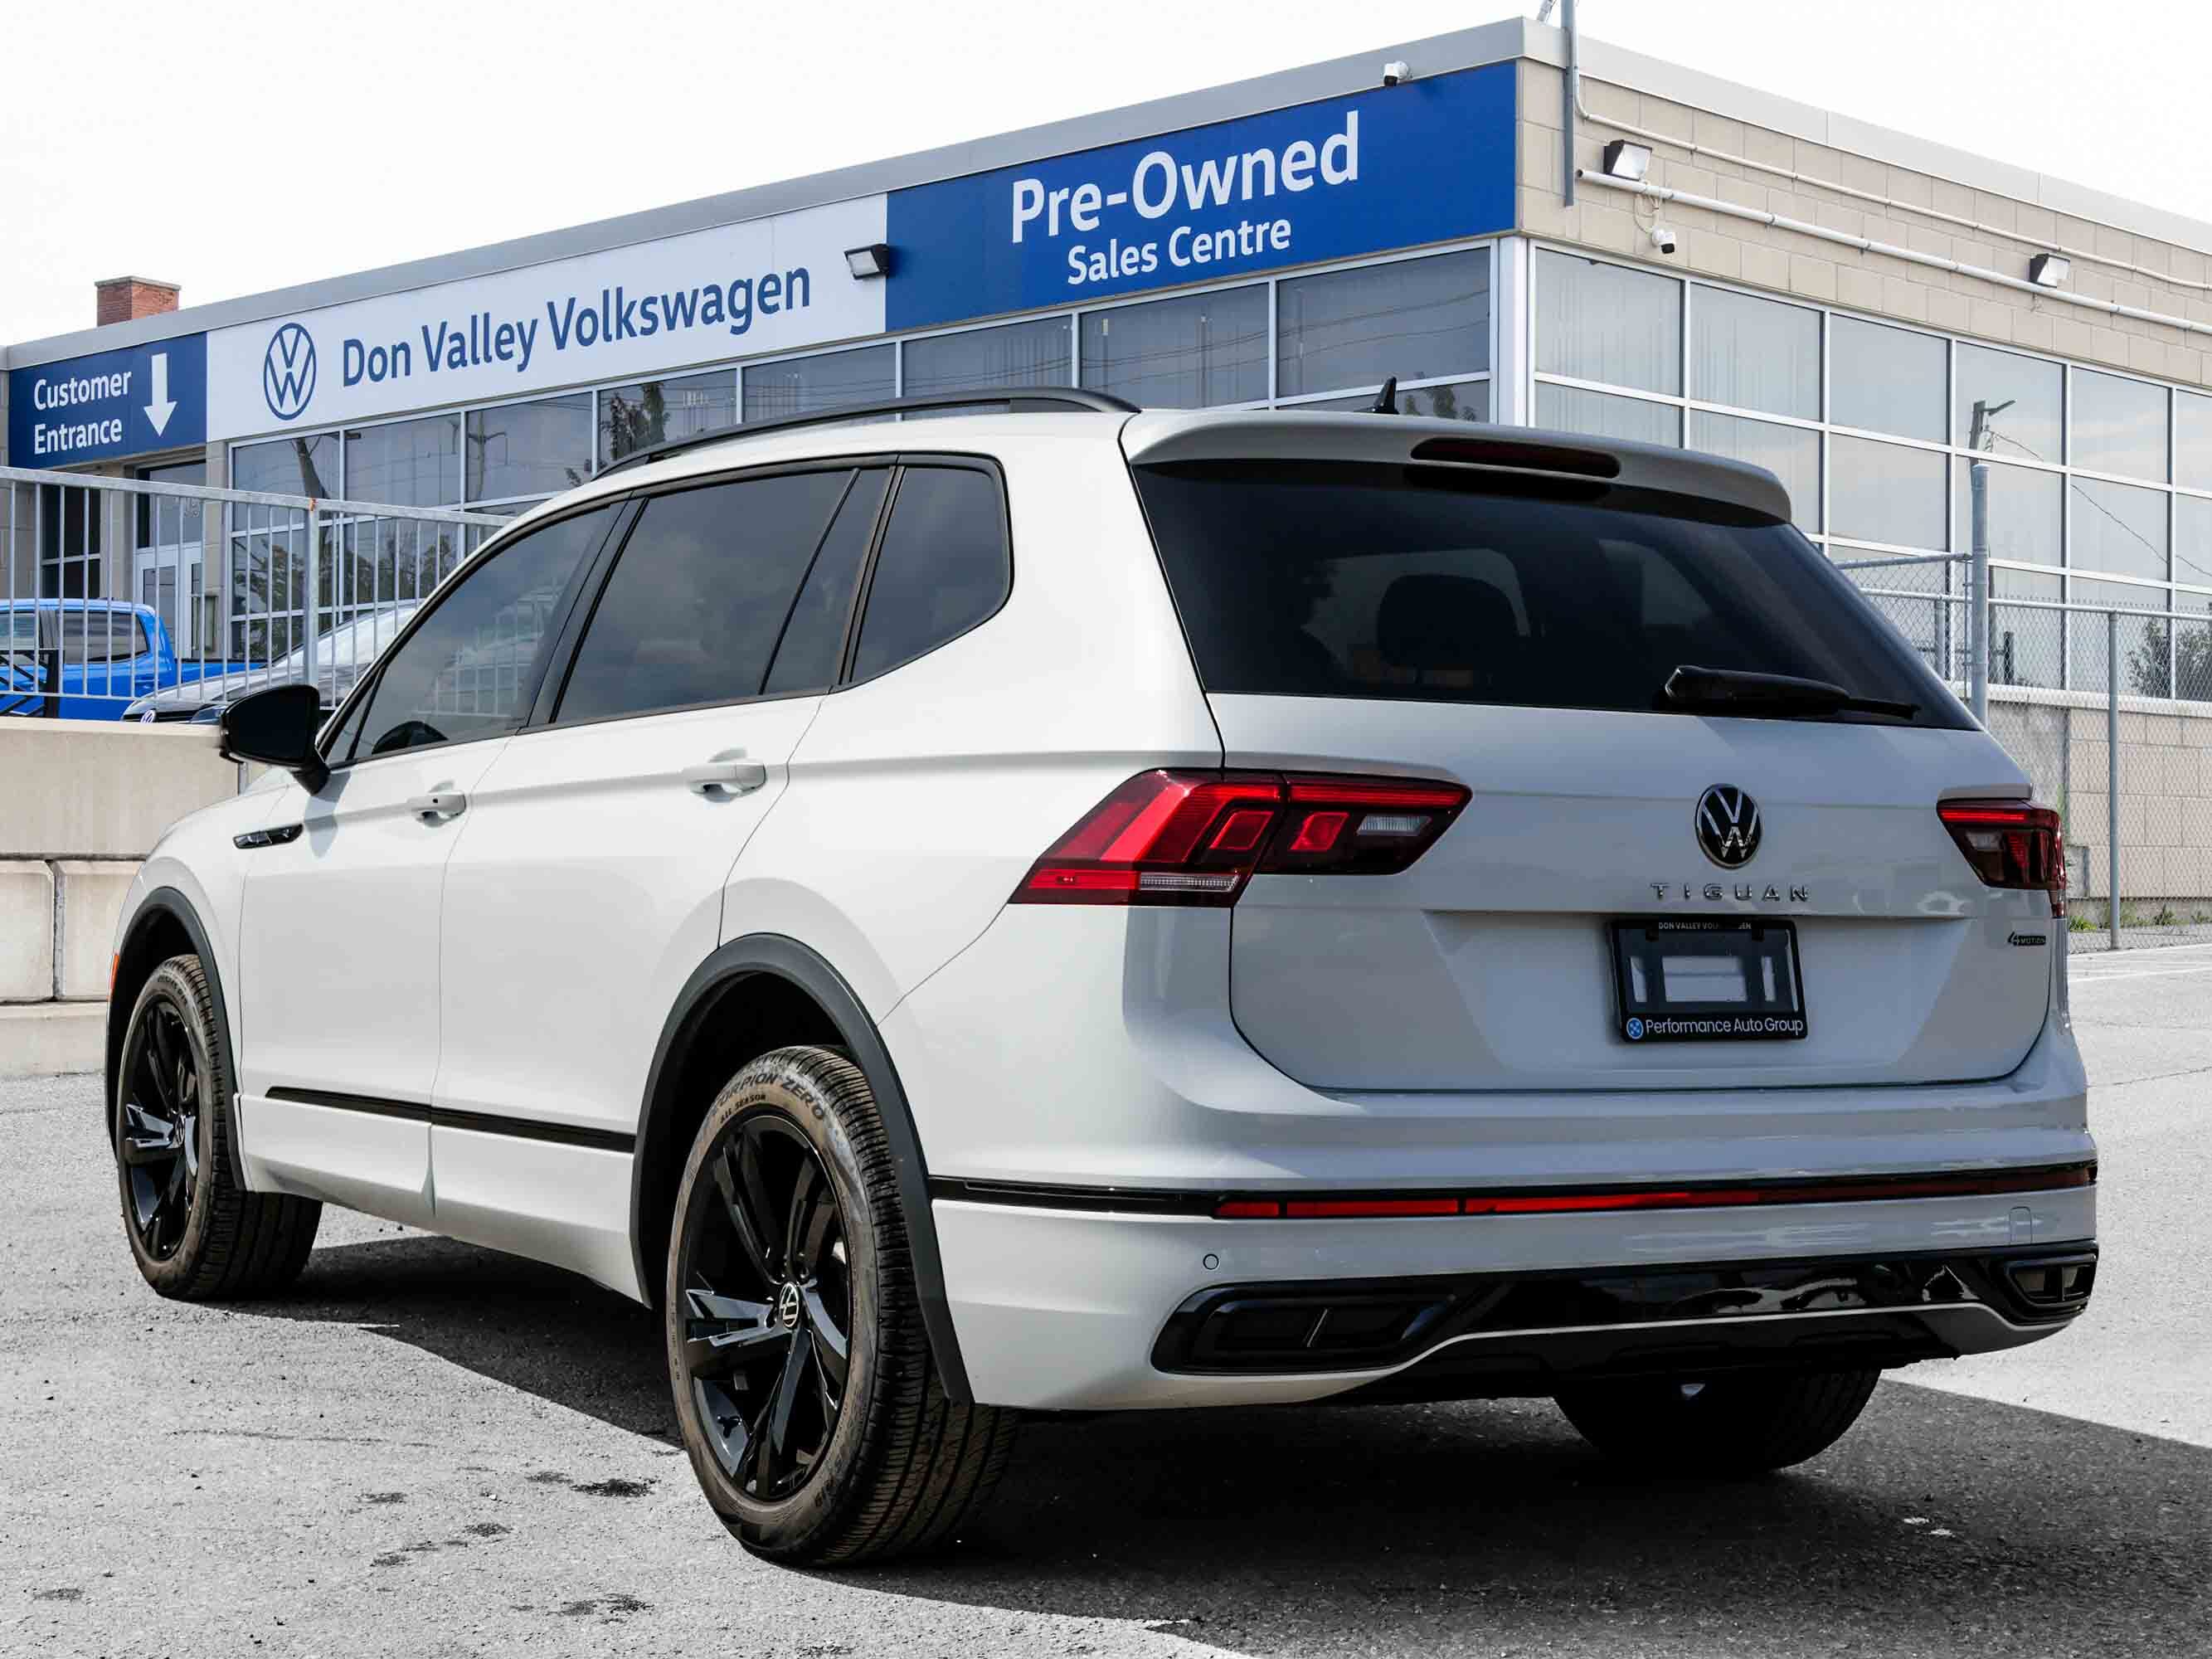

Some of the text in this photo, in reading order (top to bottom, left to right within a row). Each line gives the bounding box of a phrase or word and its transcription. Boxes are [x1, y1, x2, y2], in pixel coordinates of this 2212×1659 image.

[1011, 109, 1360, 245] Pre-Owned
[1067, 219, 1292, 286] Sales Centre
[342, 266, 812, 388] Don Valley Volkswagen
[33, 370, 133, 412] Customer
[33, 417, 123, 455] Entrance
[1650, 883, 1810, 903] TIGUAN
[1658, 922, 1675, 930] DON
[1675, 922, 1701, 930] VALLEY
[1646, 1017, 1804, 1036] Performance Auto Group
